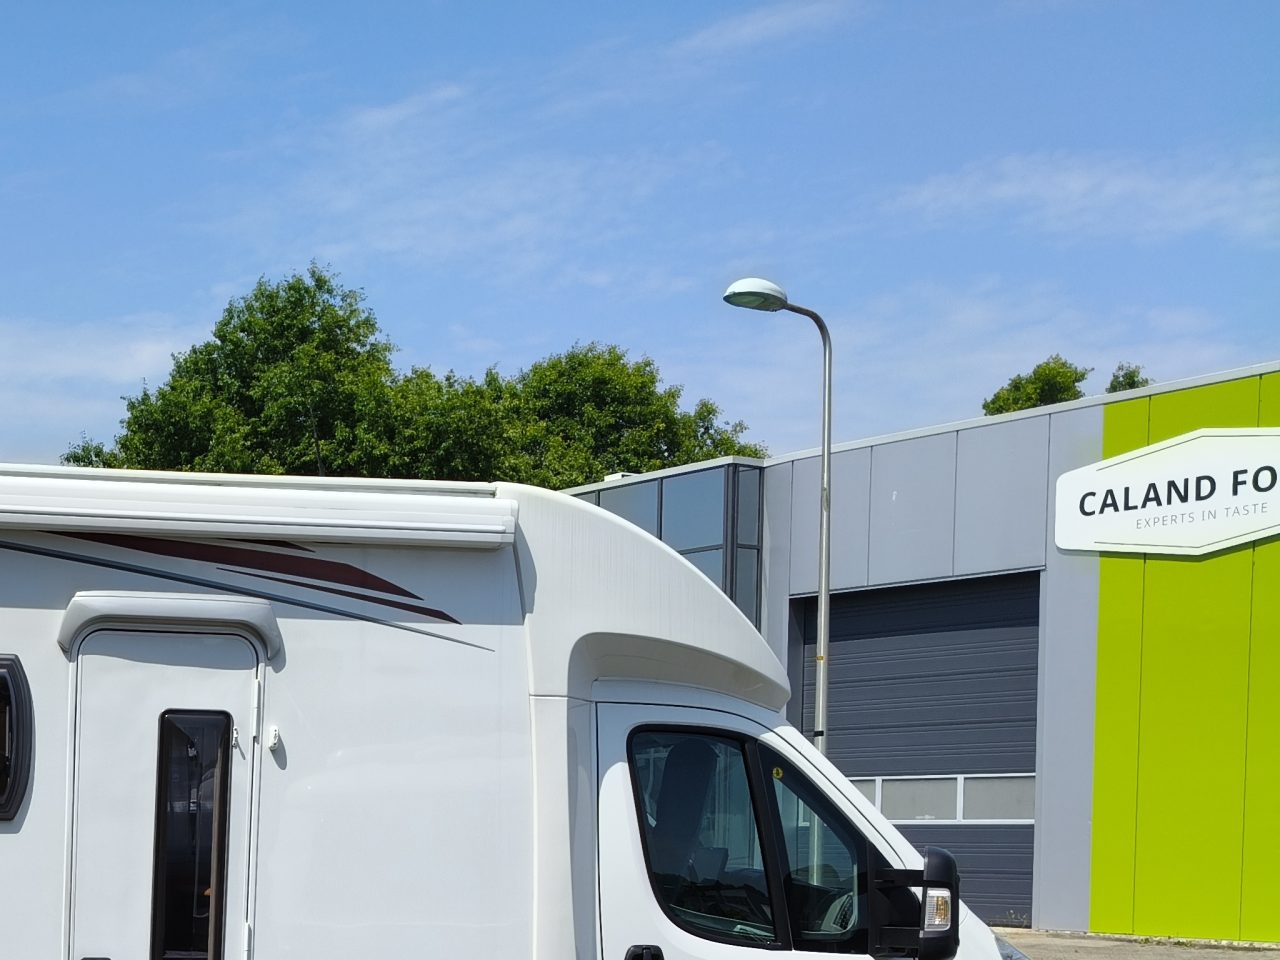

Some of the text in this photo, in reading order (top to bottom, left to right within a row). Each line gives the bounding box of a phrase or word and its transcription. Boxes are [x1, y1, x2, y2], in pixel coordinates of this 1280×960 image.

[1078, 465, 1279, 517] CALAND FO
[1135, 502, 1270, 530] EXPERTS IN TASTE
